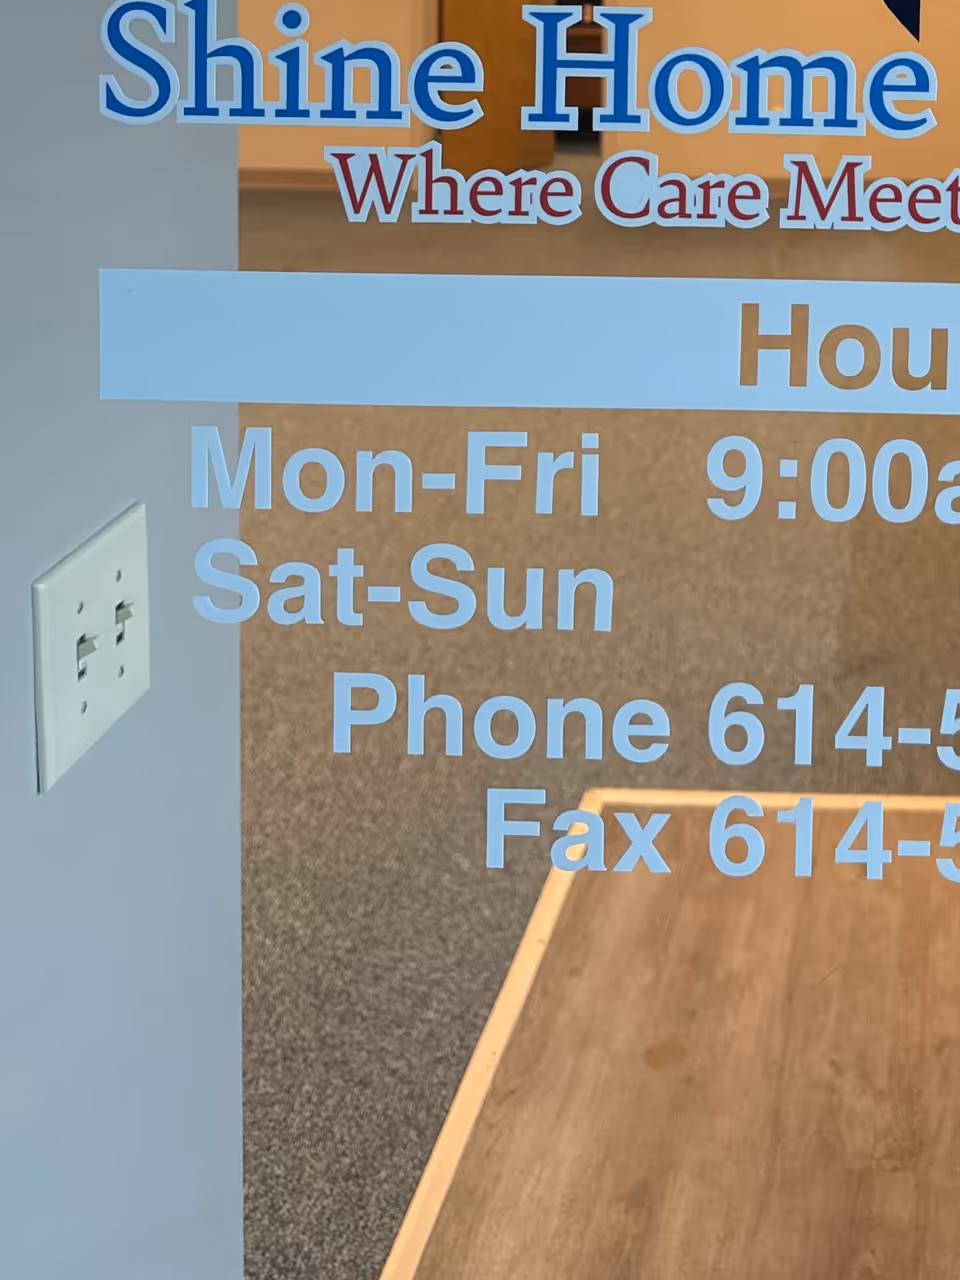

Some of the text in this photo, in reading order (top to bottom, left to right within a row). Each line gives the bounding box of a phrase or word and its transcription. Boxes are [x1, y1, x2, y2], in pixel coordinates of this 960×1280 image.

[521, 6, 937, 138] Home
[327, 143, 580, 223] Where
[597, 153, 766, 224] Care
[190, 425, 600, 517] Mon-Fri
[192, 538, 615, 633] Sat-Sun
[332, 671, 672, 763] Phone
[485, 787, 672, 874] Fax
